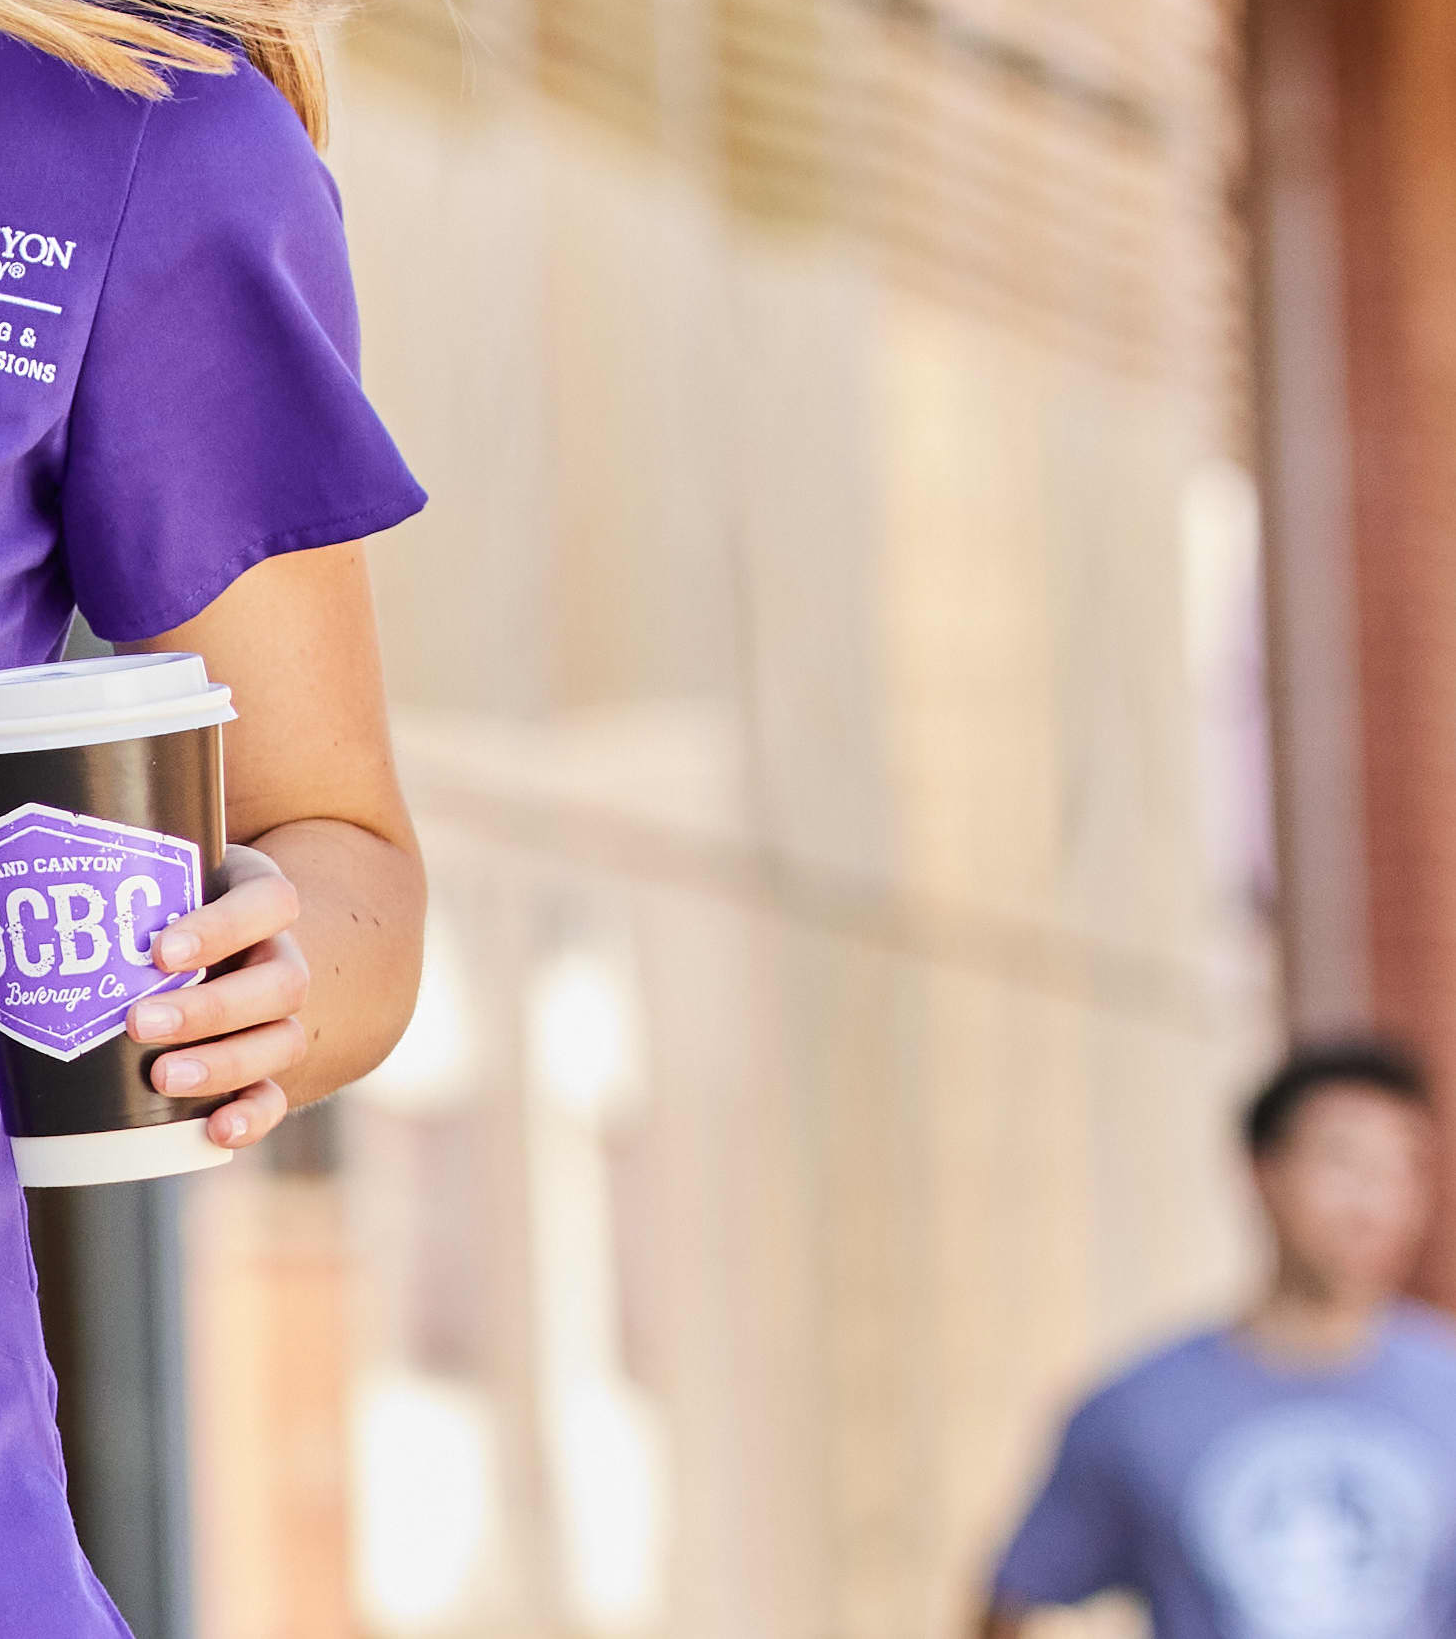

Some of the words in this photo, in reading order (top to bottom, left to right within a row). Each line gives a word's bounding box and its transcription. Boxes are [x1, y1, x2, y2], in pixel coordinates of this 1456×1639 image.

[20, 328, 36, 348] &
[34, 855, 123, 872] CANYON
[5, 983, 91, 1012] Beverage
[99, 974, 127, 998] Co.
